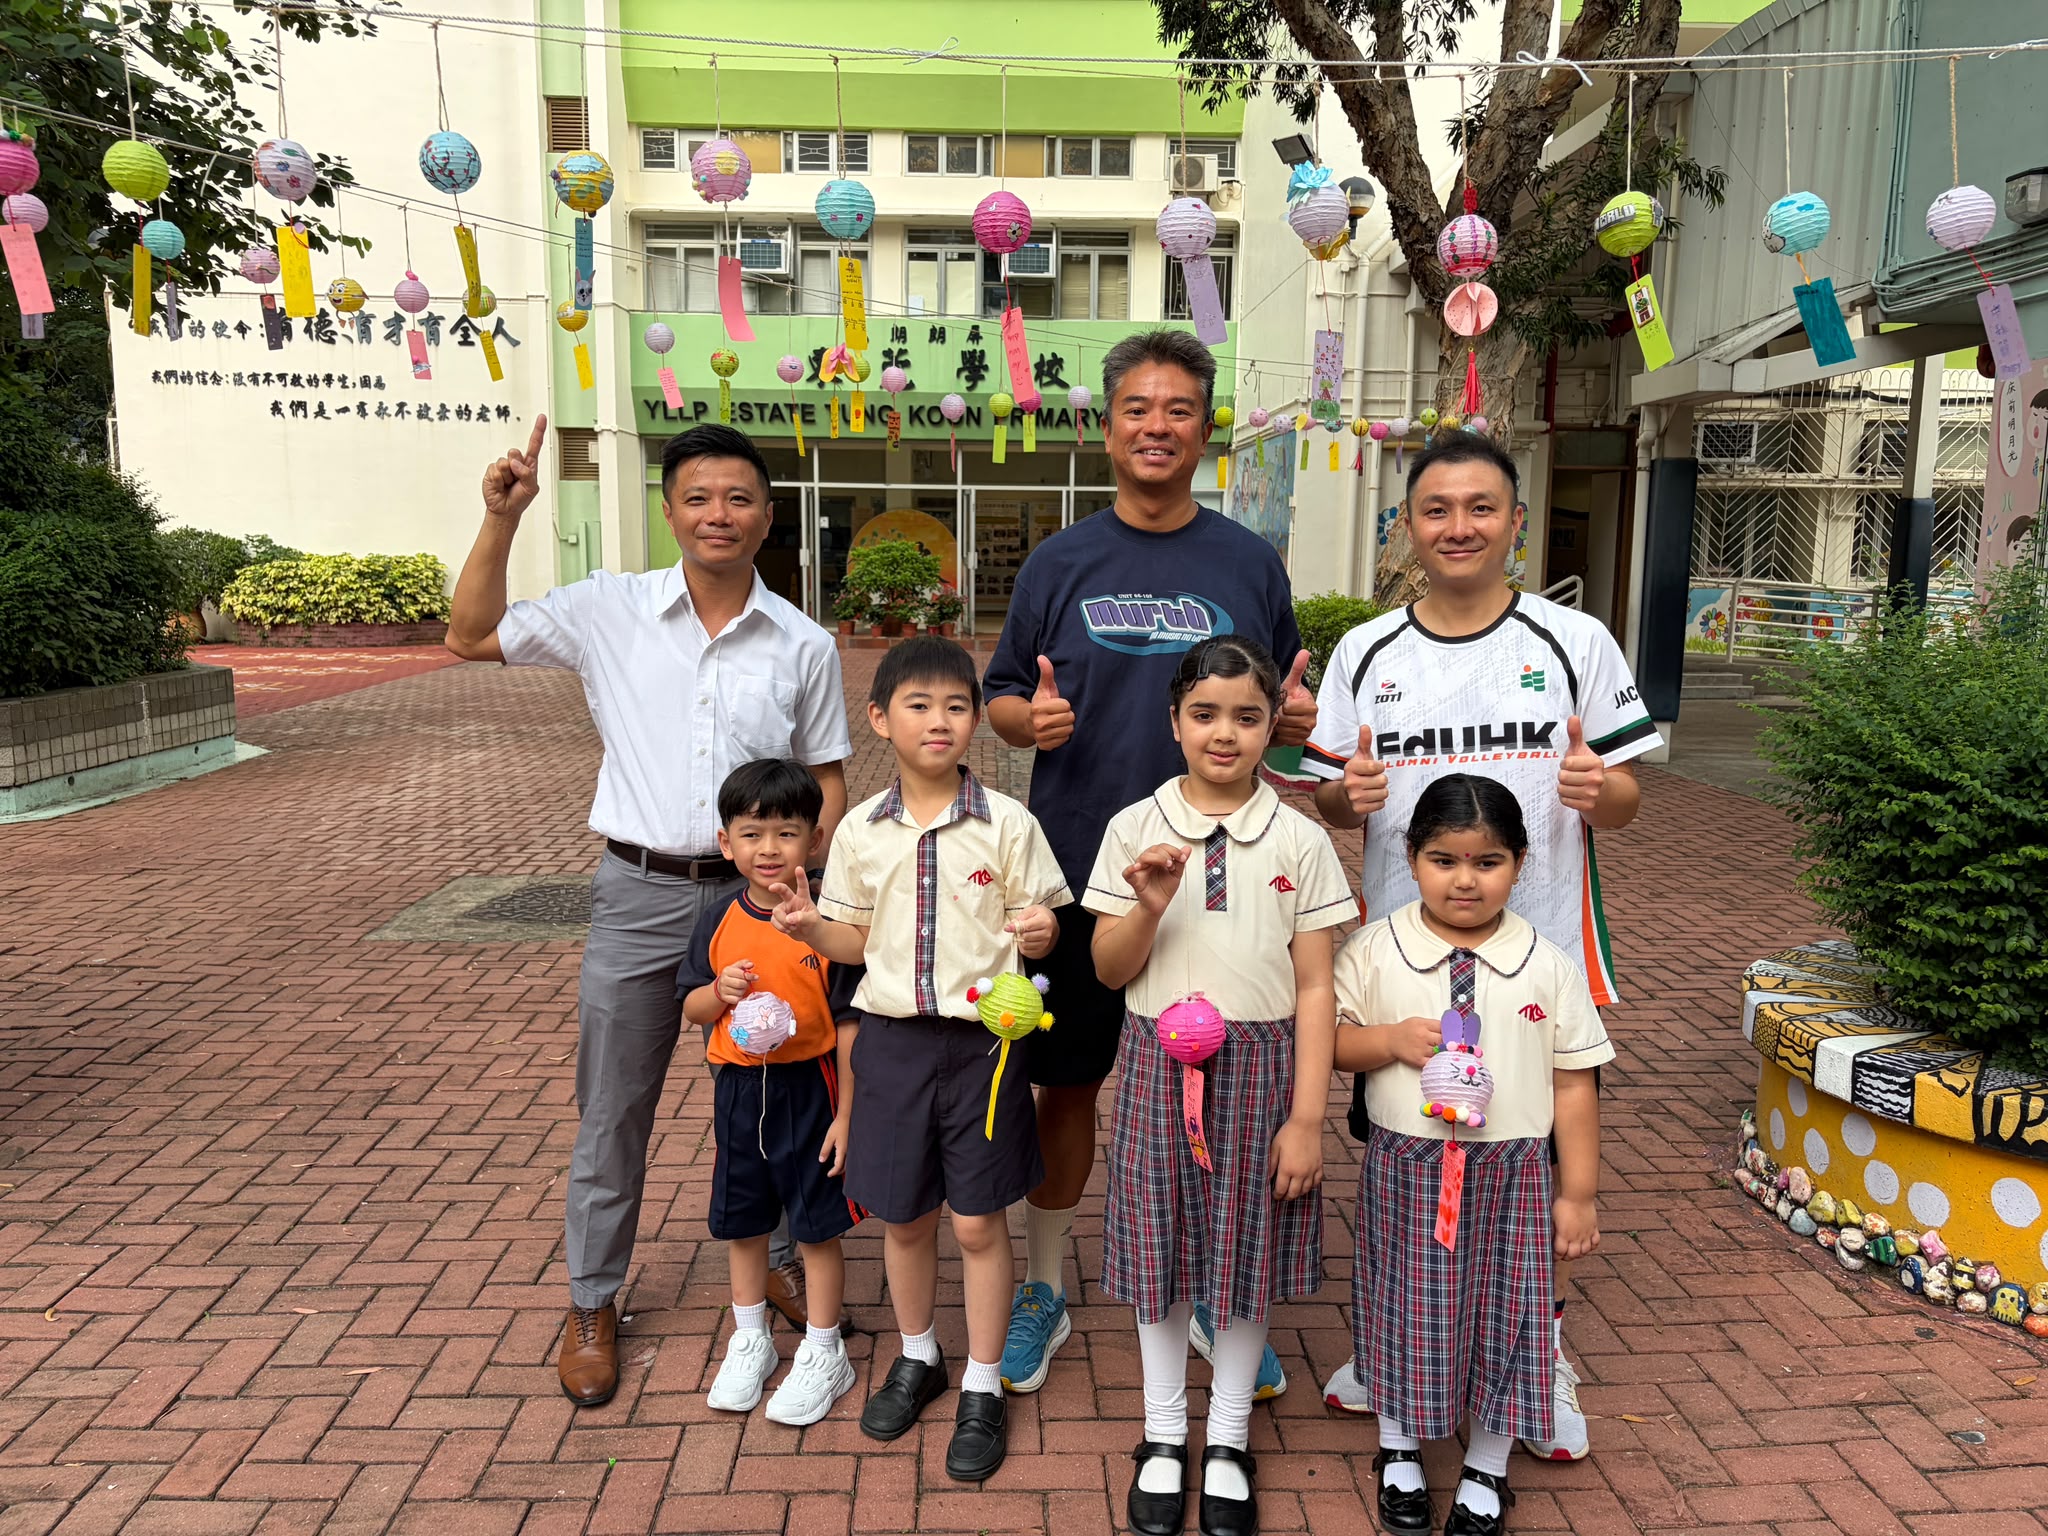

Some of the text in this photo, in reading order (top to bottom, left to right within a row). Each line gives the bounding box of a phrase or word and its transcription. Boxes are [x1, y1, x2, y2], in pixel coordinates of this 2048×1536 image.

[644, 400, 708, 422] YLLP
[908, 405, 982, 428] KON
[993, 407, 1103, 429] RMARY
[1381, 750, 1560, 769] LUMNI VOLLEYBALL
